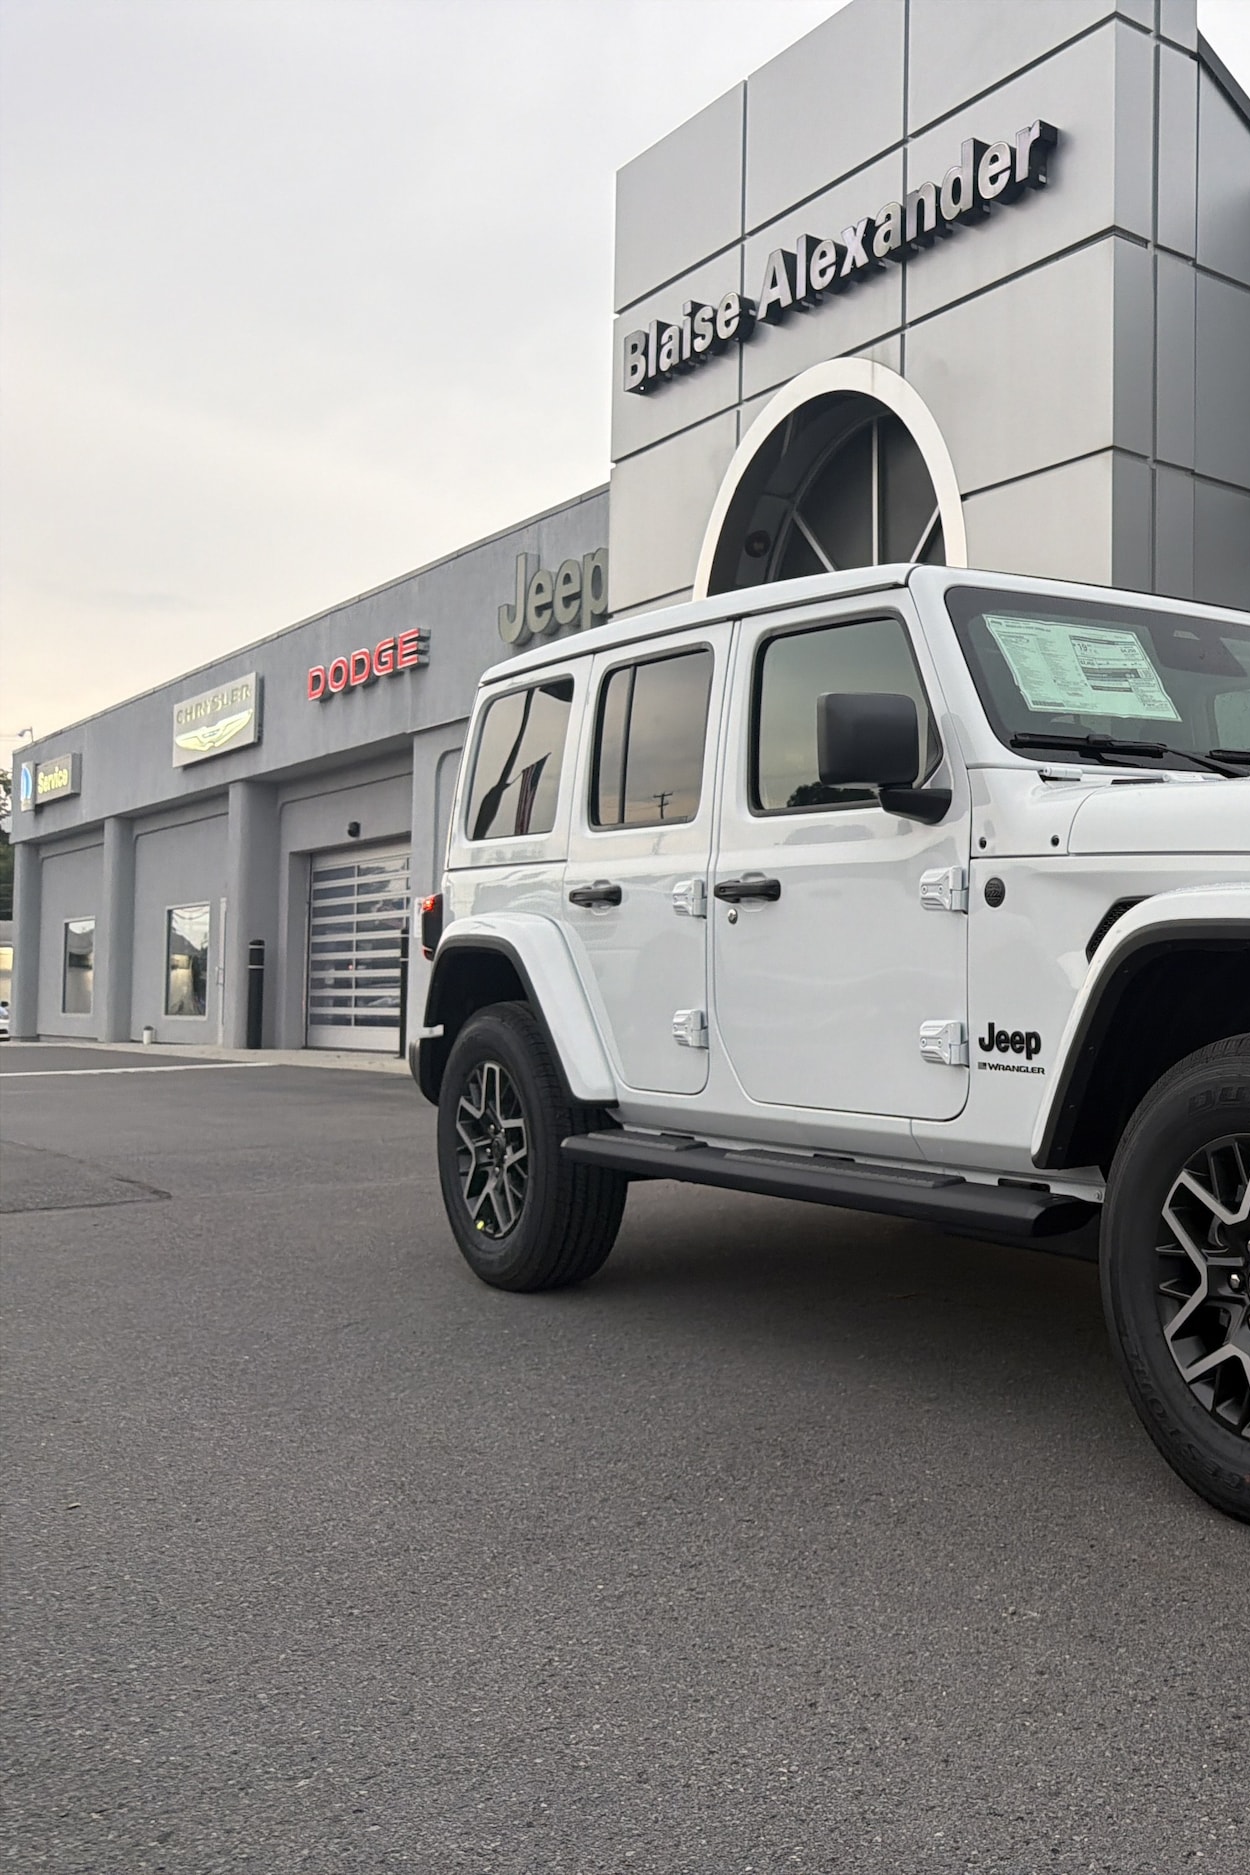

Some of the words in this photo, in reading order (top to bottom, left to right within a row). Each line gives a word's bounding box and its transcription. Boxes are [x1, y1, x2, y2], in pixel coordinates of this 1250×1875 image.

[624, 290, 746, 392] Blaise
[757, 119, 1052, 323] Alexander
[498, 547, 608, 646] Jeep
[307, 627, 424, 701] DODGE
[176, 684, 251, 725] CHRYSLER
[37, 765, 69, 795] Service
[978, 1022, 1042, 1061] Jeep
[987, 1062, 1046, 1075] WRANGLER
